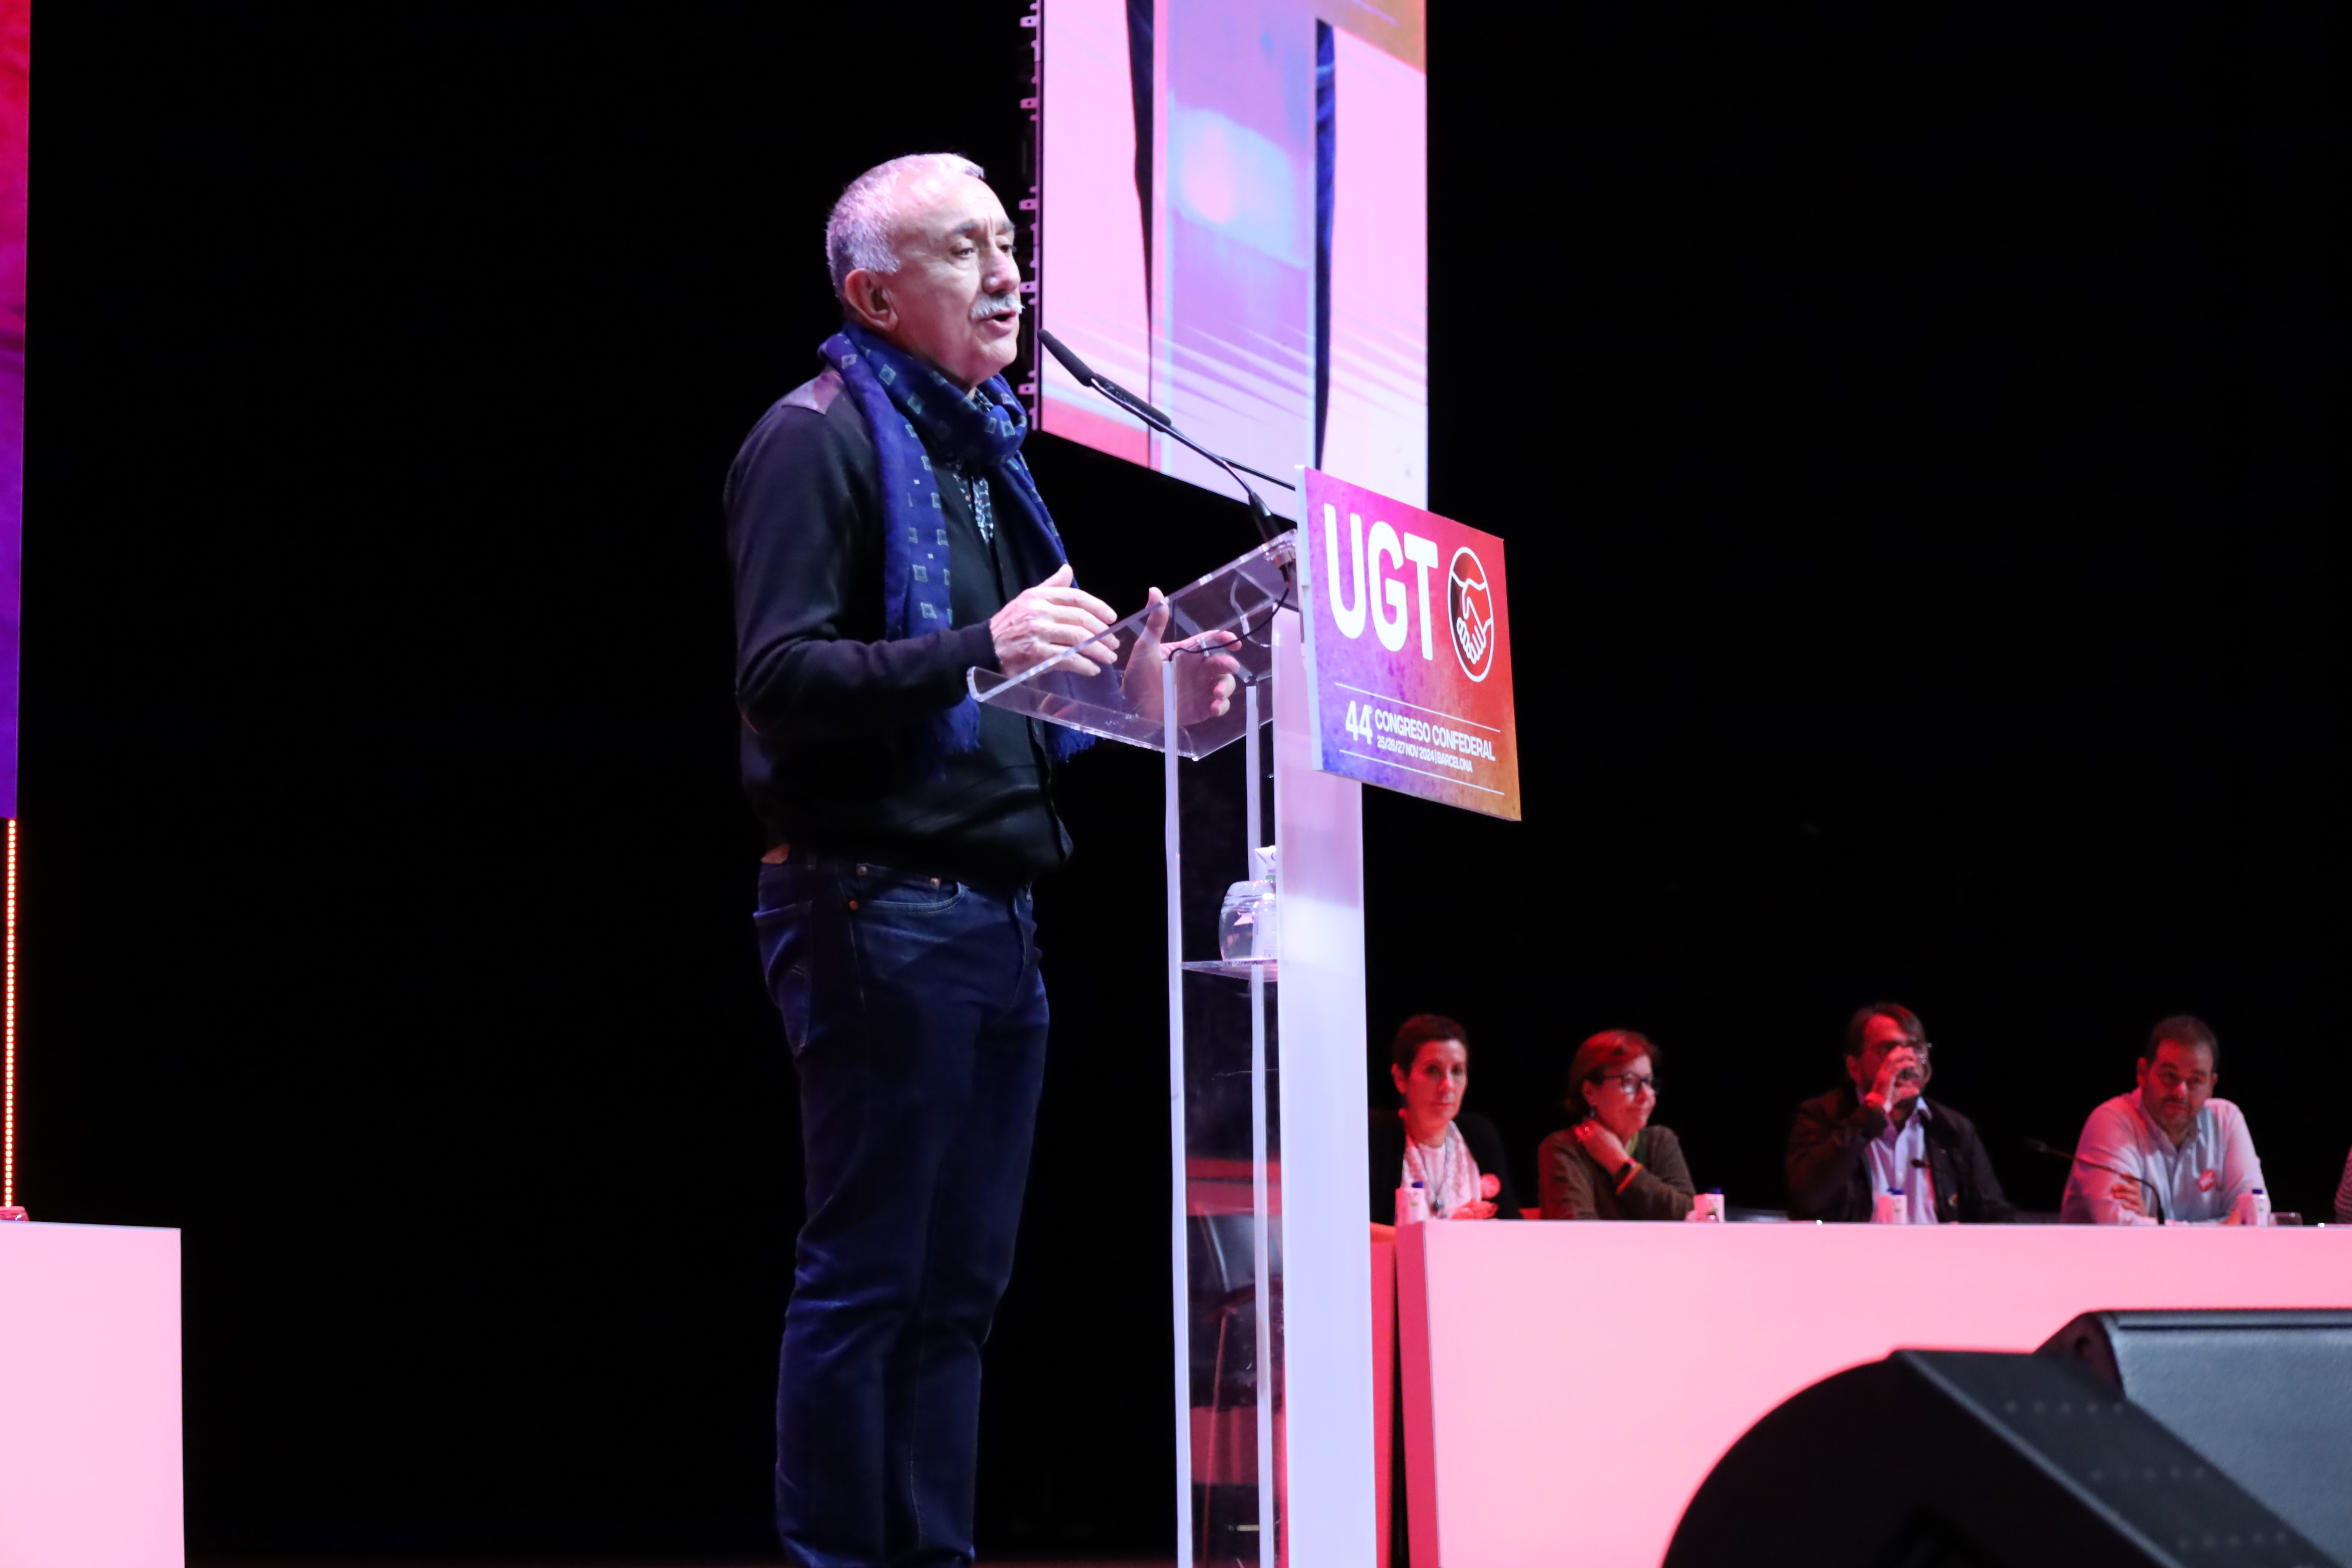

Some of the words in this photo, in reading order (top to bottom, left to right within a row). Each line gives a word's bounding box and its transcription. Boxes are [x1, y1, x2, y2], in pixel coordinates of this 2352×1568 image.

[1323, 502, 1438, 660] UGT
[1375, 709, 1431, 743] CONGRESO
[1432, 725, 1496, 761] CONFEDERAL
[1377, 735, 1405, 754] 25/26/27
[1405, 743, 1418, 758] NOV
[1437, 751, 1473, 773] BARCELONA
